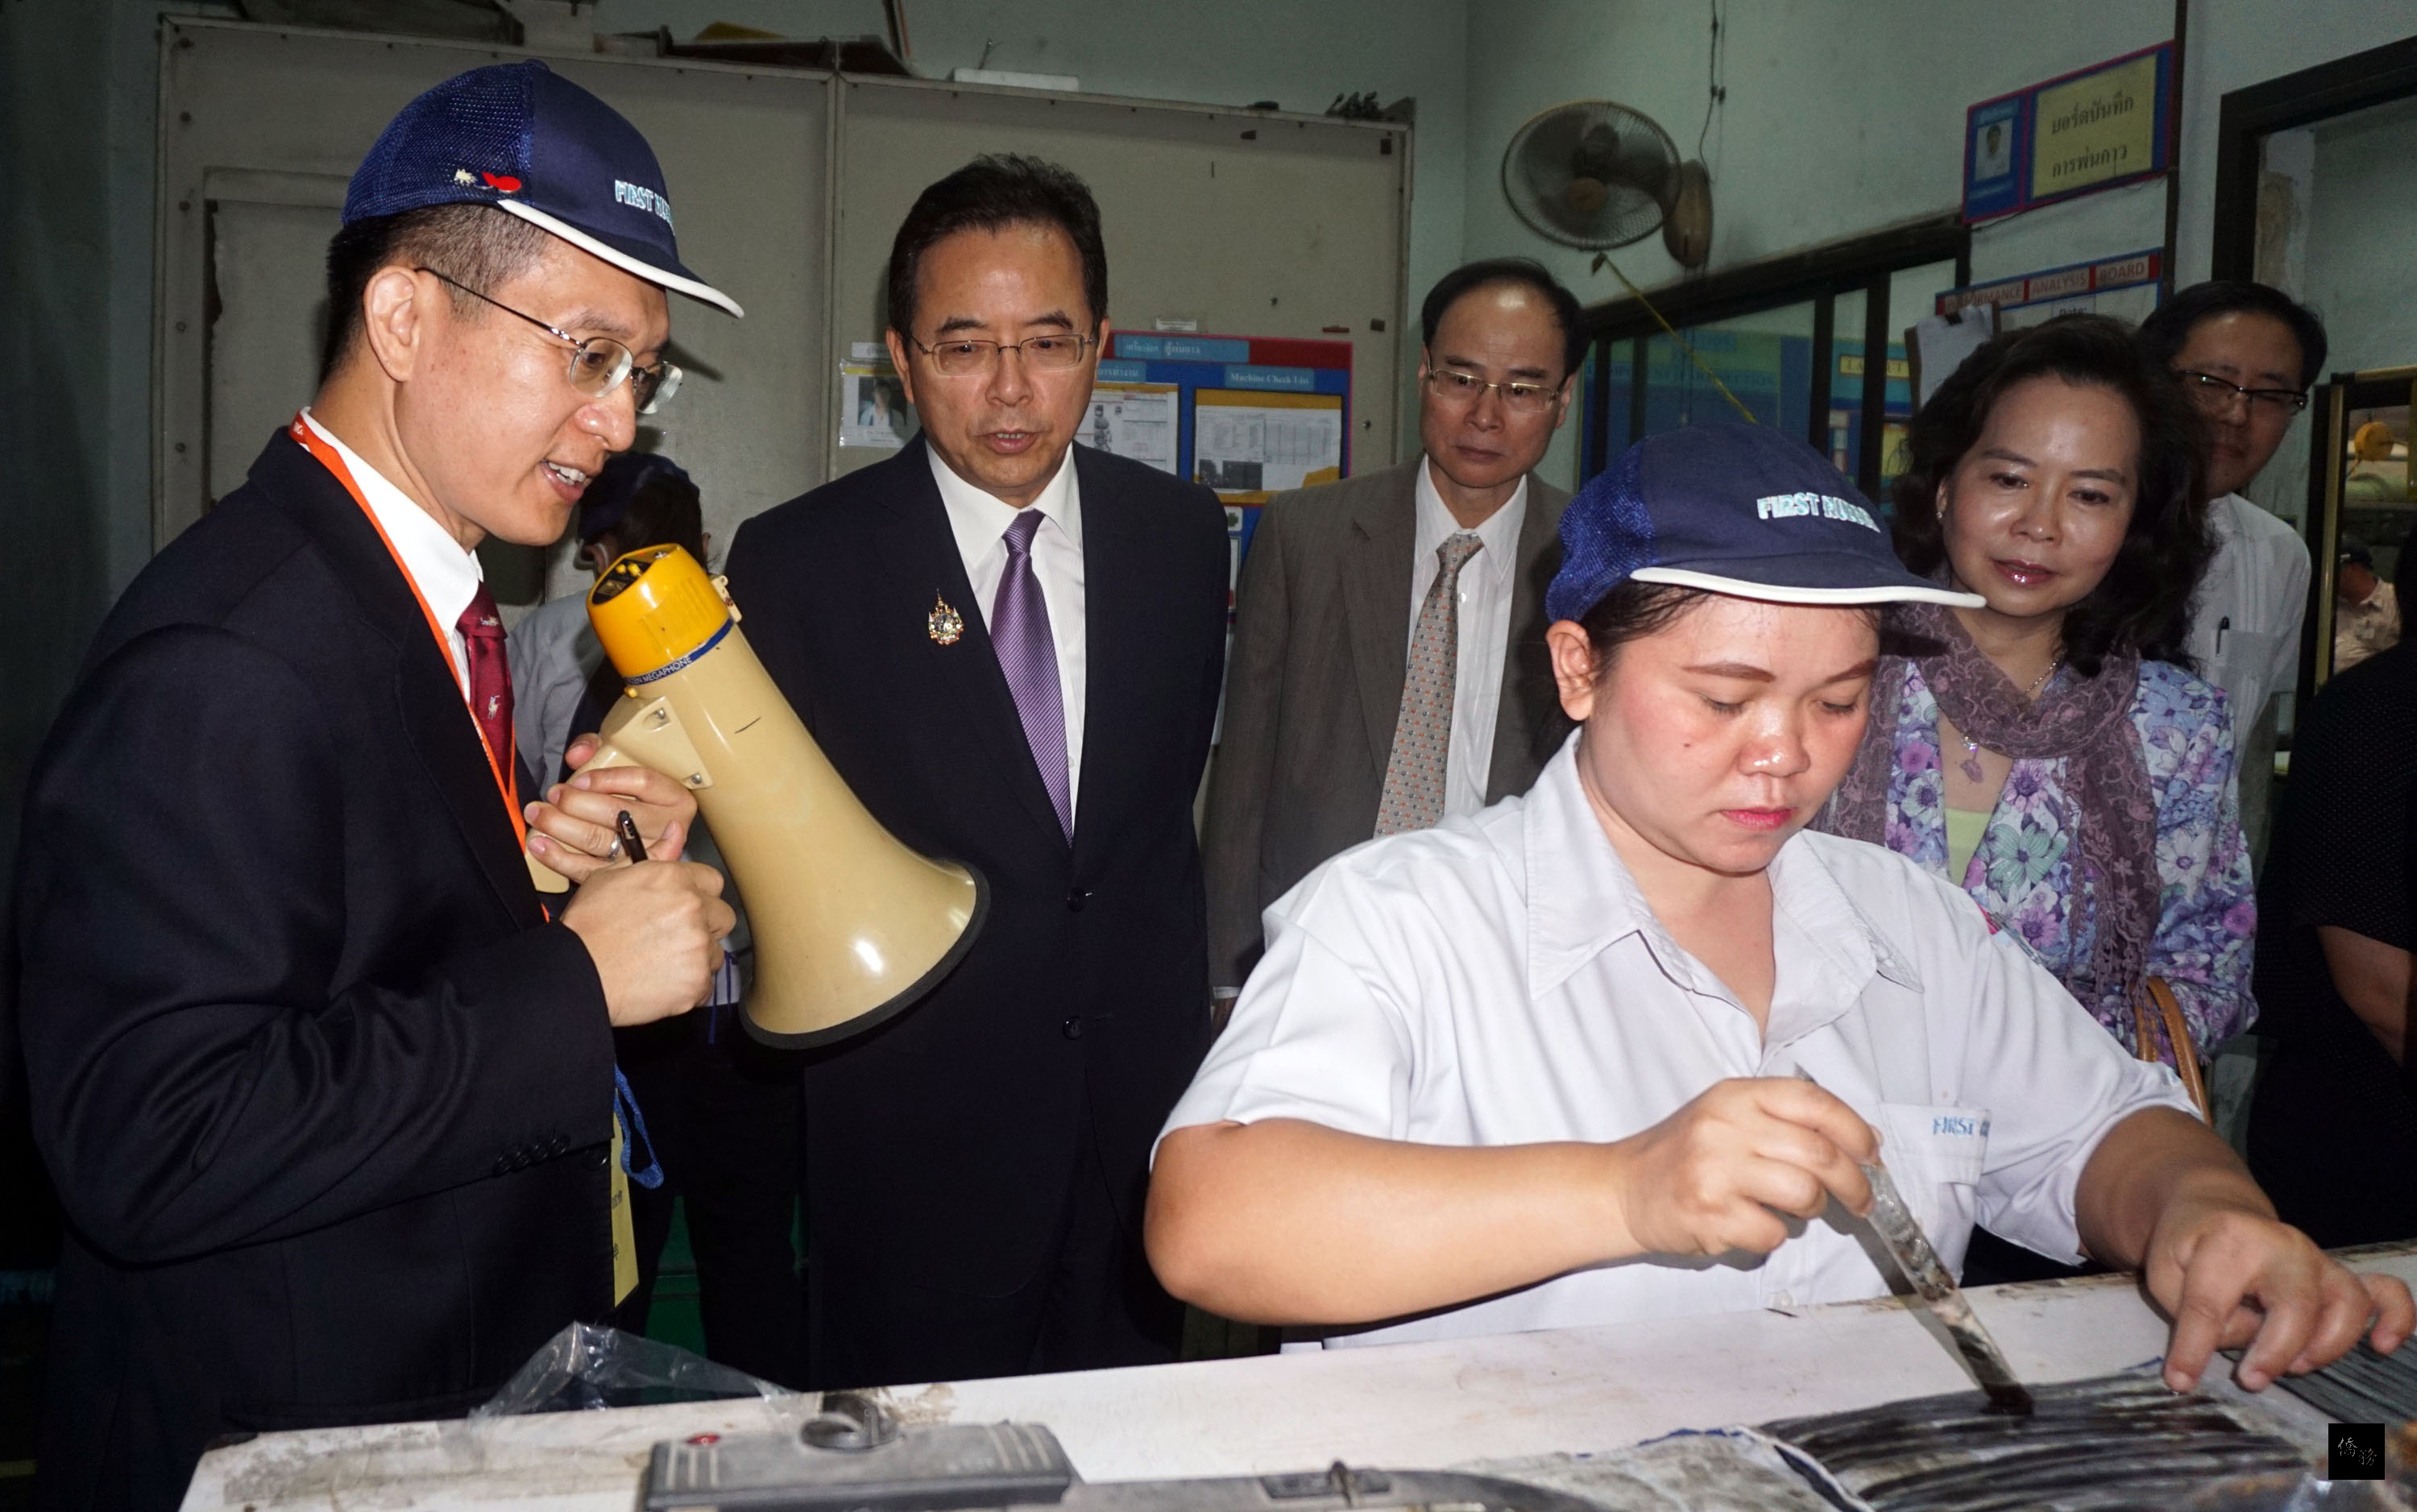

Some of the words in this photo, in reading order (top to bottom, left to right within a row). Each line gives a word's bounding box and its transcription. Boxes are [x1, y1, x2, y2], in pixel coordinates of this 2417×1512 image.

[2051, 91, 2133, 134] บอร์ดบันทึก
[2052, 144, 2128, 178] การพ่นกาว
[615, 180, 653, 211] FIRST
[2032, 274, 2087, 292] ANALYSIS
[2099, 263, 2145, 281] BOARD
[1230, 372, 1266, 383] Machine
[1267, 374, 1291, 384] Check
[1294, 375, 1309, 385] List
[1756, 492, 1819, 520] FIRST
[643, 657, 692, 682] MEGAPHONE
[1933, 1116, 1975, 1137] FIRST
